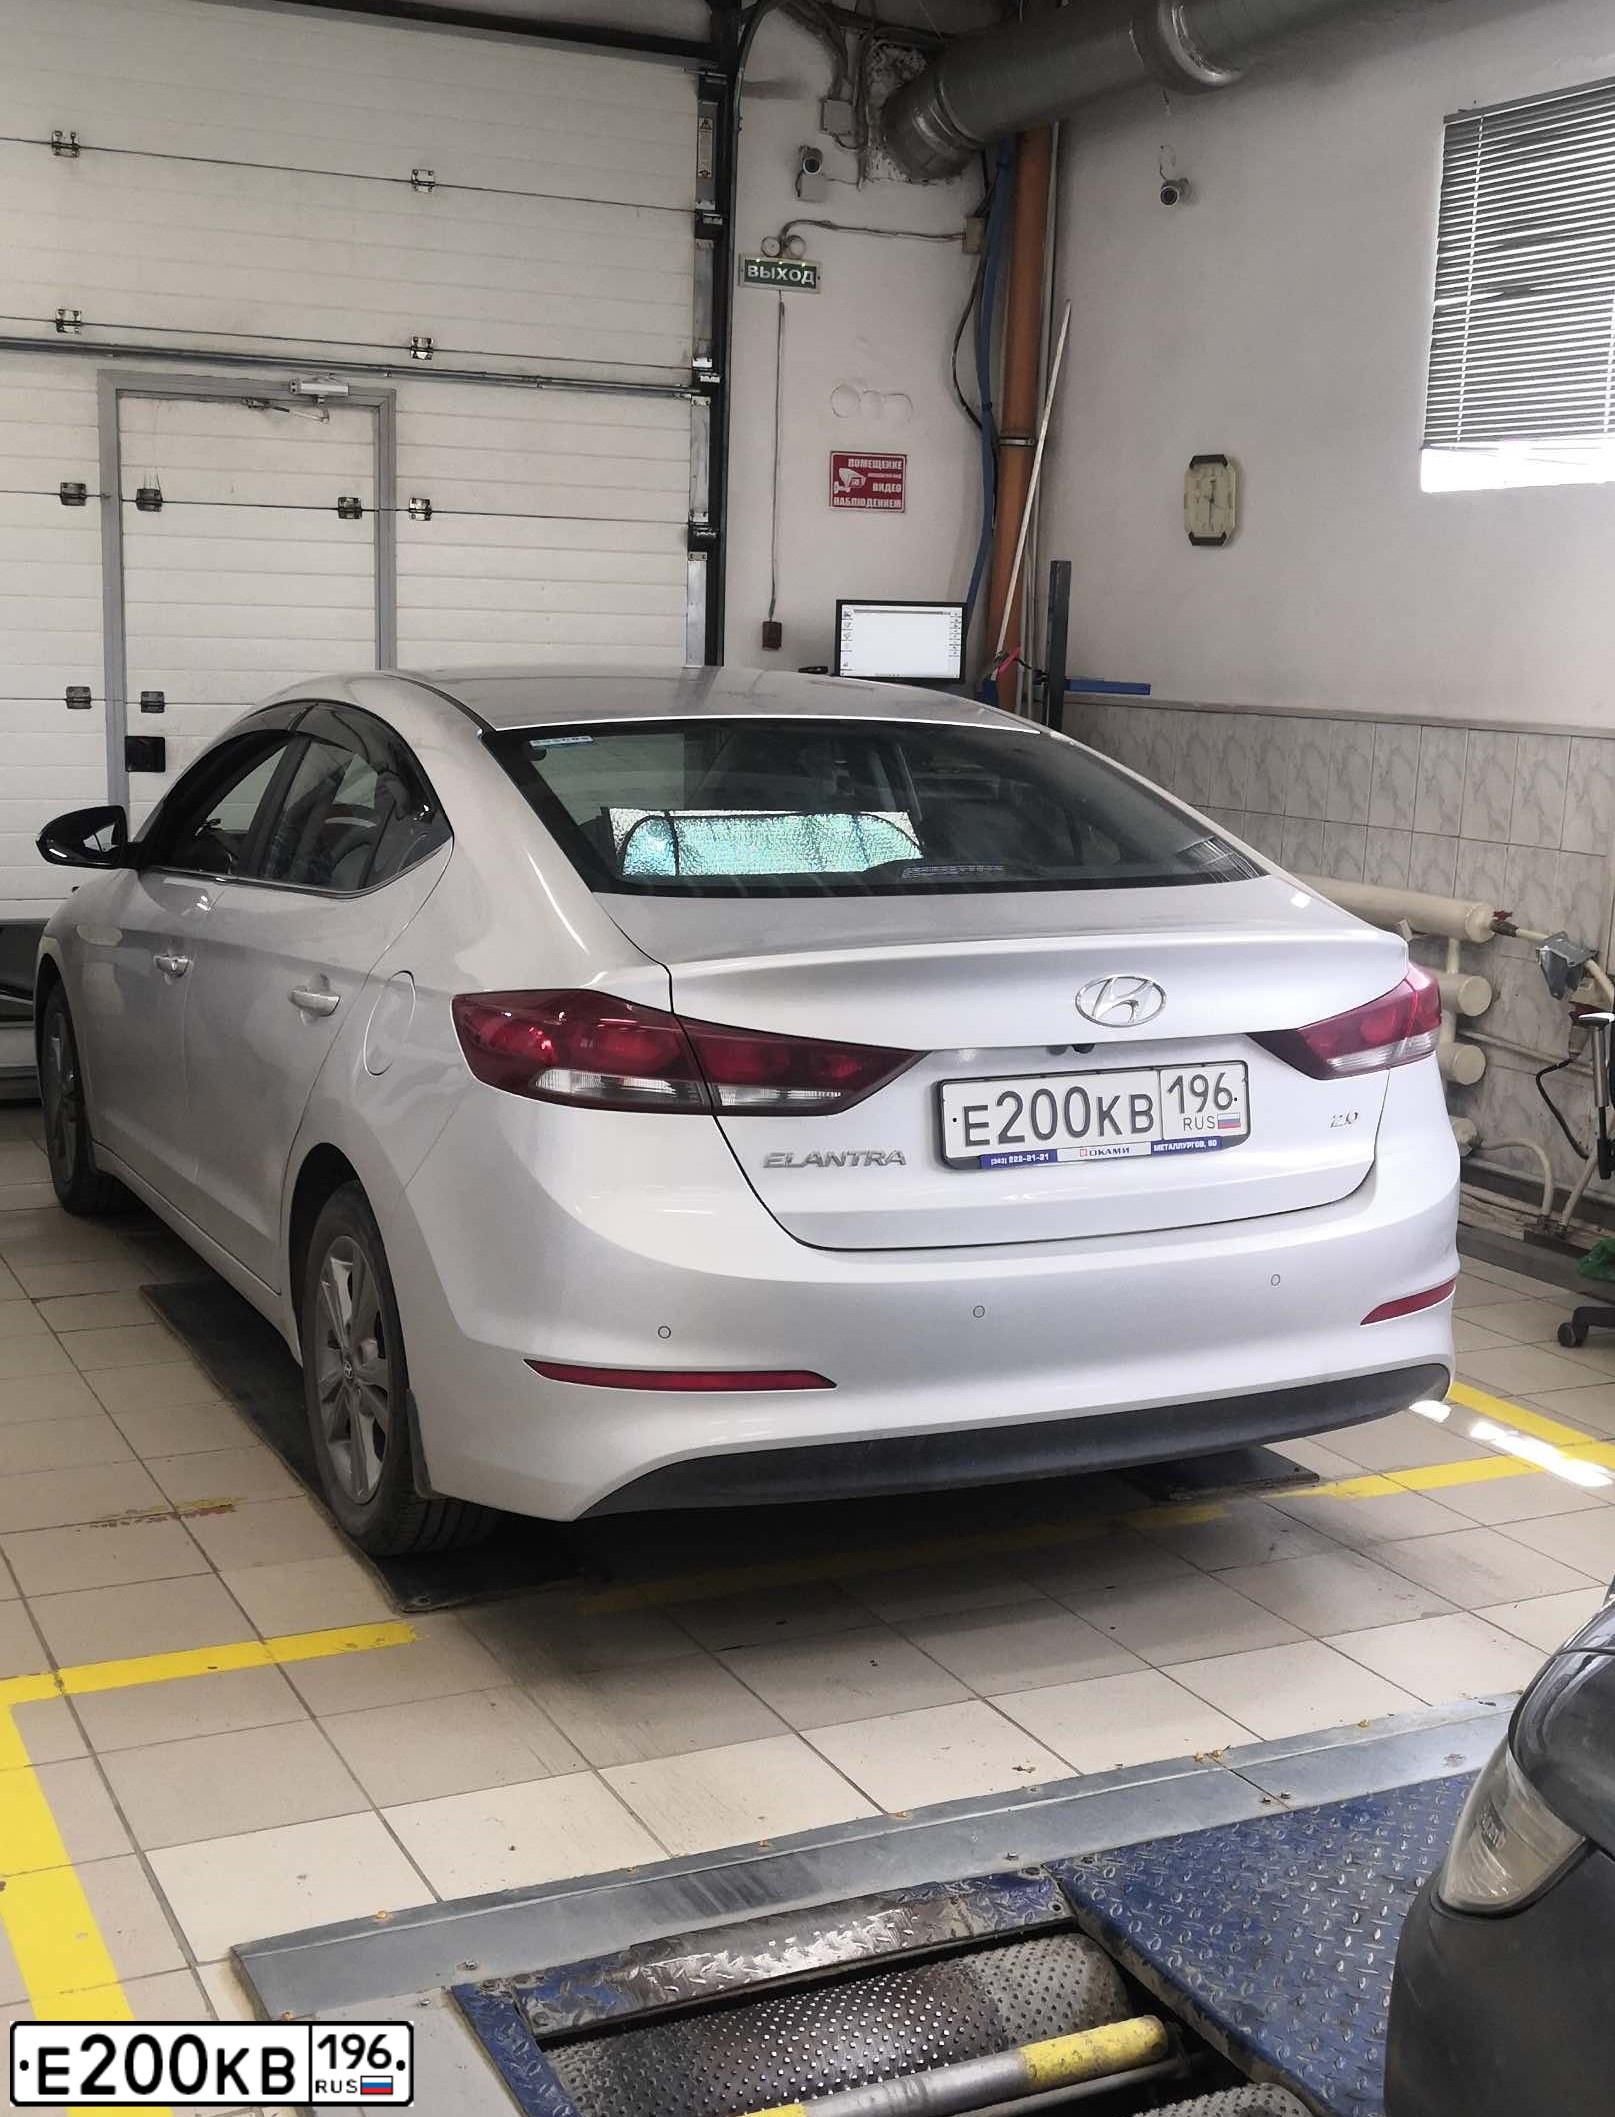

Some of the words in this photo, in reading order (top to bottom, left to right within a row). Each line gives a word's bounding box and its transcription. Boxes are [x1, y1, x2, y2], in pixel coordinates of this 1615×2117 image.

[747, 265, 814, 285] ВЫХОД
[1167, 1072, 1233, 1114] 196
[1183, 1115, 1215, 1132] RUS
[763, 1150, 907, 1168] ELANTRA
